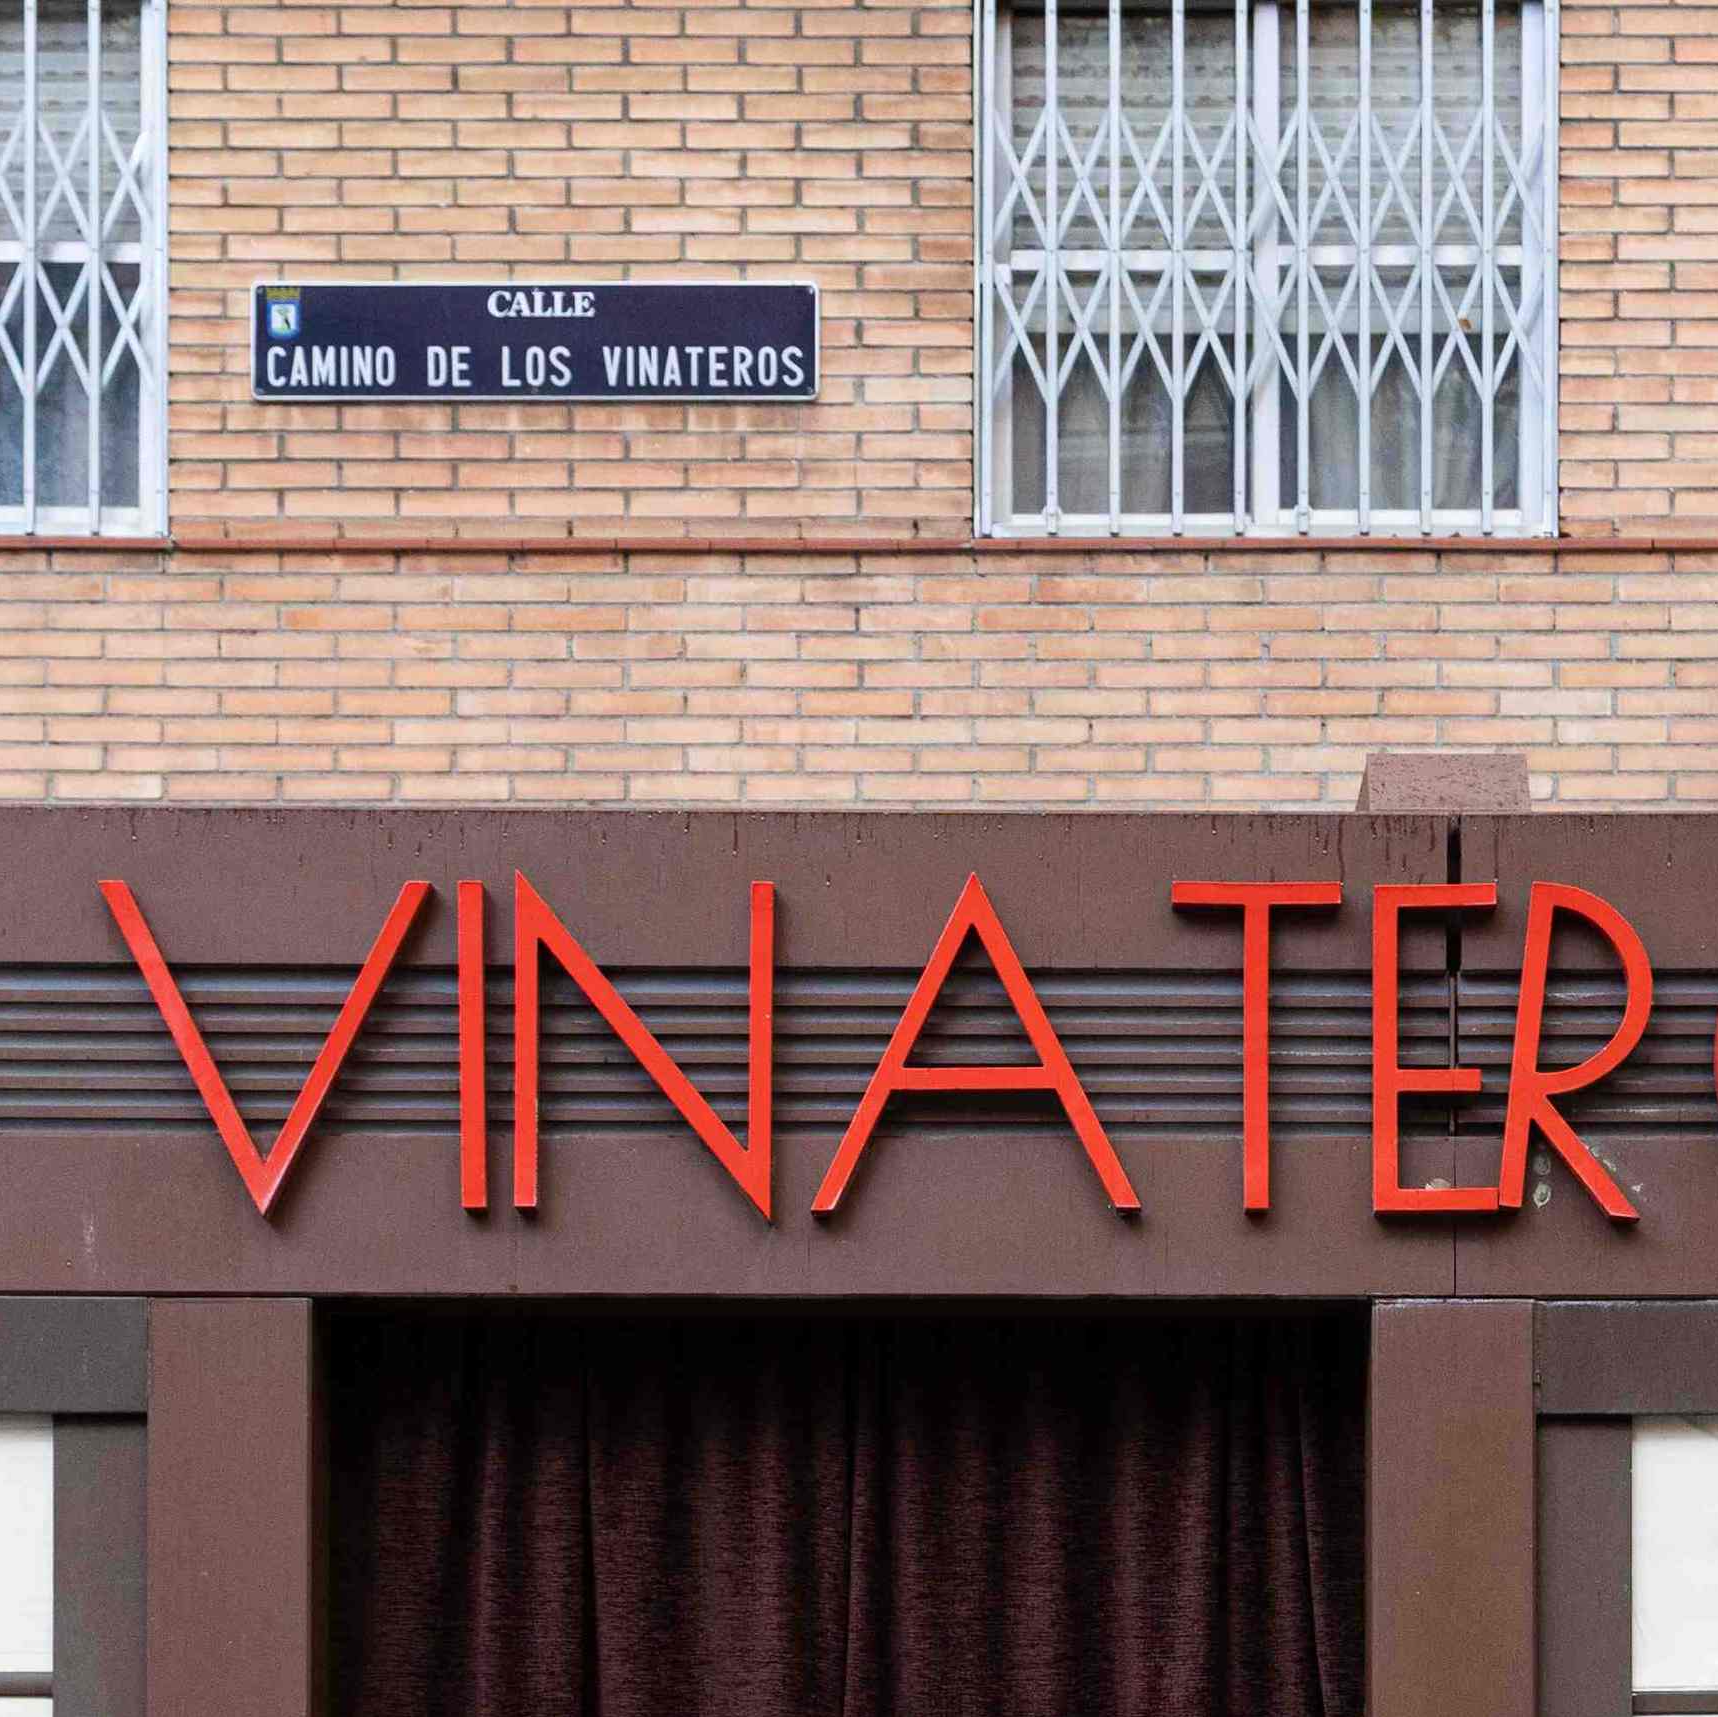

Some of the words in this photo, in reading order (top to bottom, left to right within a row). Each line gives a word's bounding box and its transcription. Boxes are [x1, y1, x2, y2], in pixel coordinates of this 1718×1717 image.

[486, 289, 596, 318] CALLE
[266, 345, 396, 387] CAMINO
[426, 345, 472, 387] DE
[500, 345, 572, 387] LOS
[601, 345, 805, 387] VINATEROS
